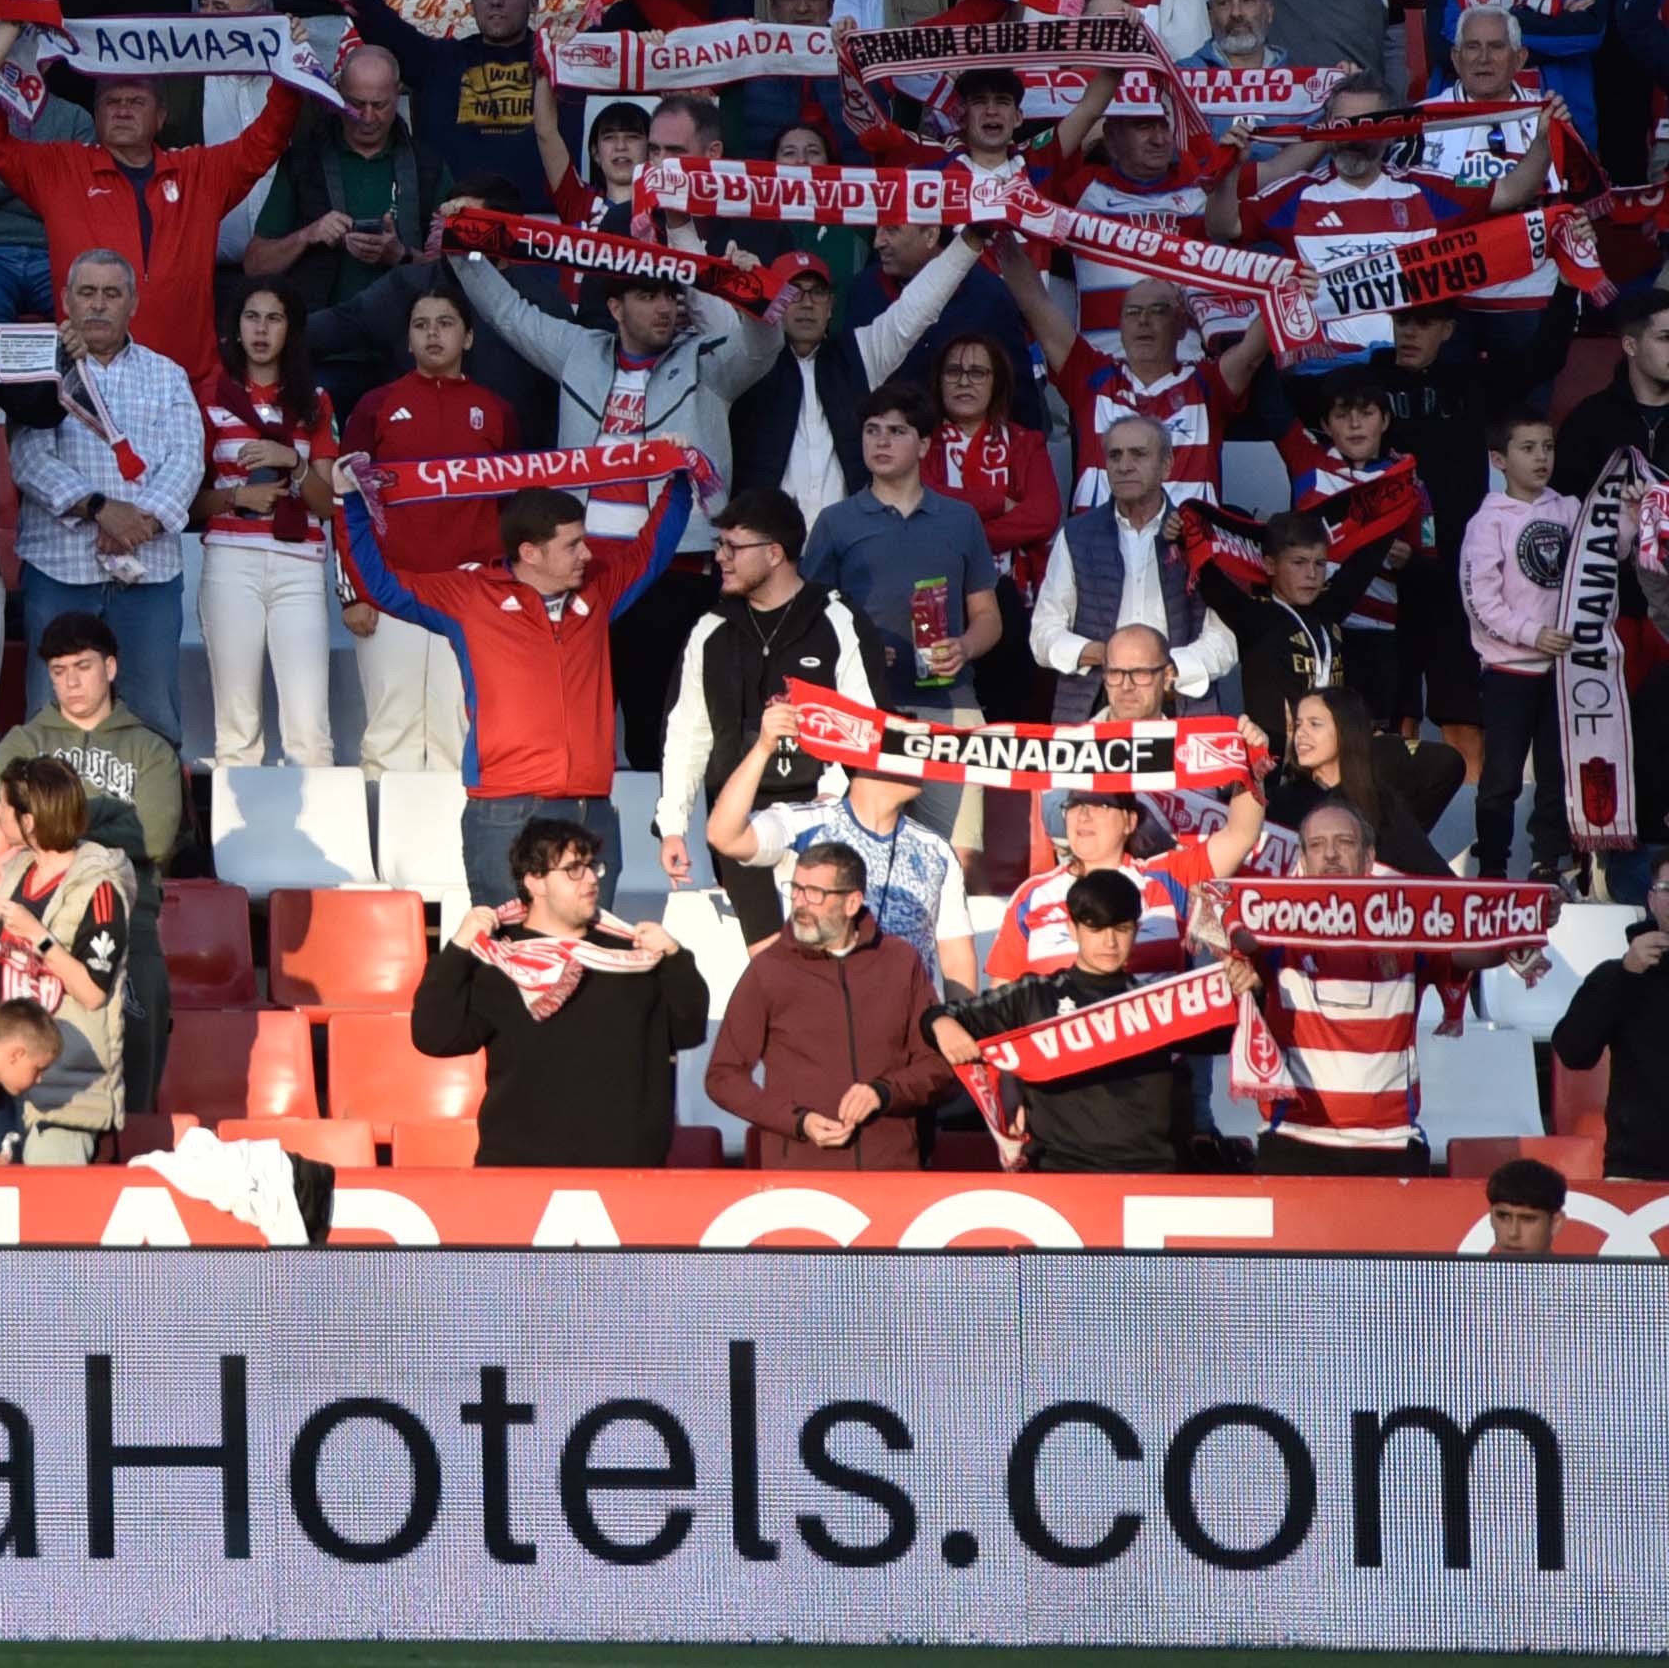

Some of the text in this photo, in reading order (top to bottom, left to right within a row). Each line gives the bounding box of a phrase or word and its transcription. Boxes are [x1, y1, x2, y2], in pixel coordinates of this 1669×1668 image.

[650, 33, 794, 71] GRANADA
[848, 26, 956, 65] GRANADA
[964, 22, 1028, 55] CLUB
[1037, 21, 1065, 51] DE
[474, 98, 534, 117] NATUR
[1181, 241, 1298, 285] VAMOS
[1397, 230, 1477, 267] CLUB DE
[1328, 250, 1489, 315] GRANADA
[417, 439, 657, 497] GRANADA C.F.
[1239, 889, 1542, 938] Granada Club de Fútbol
[1030, 971, 1232, 1057] GRANADA
